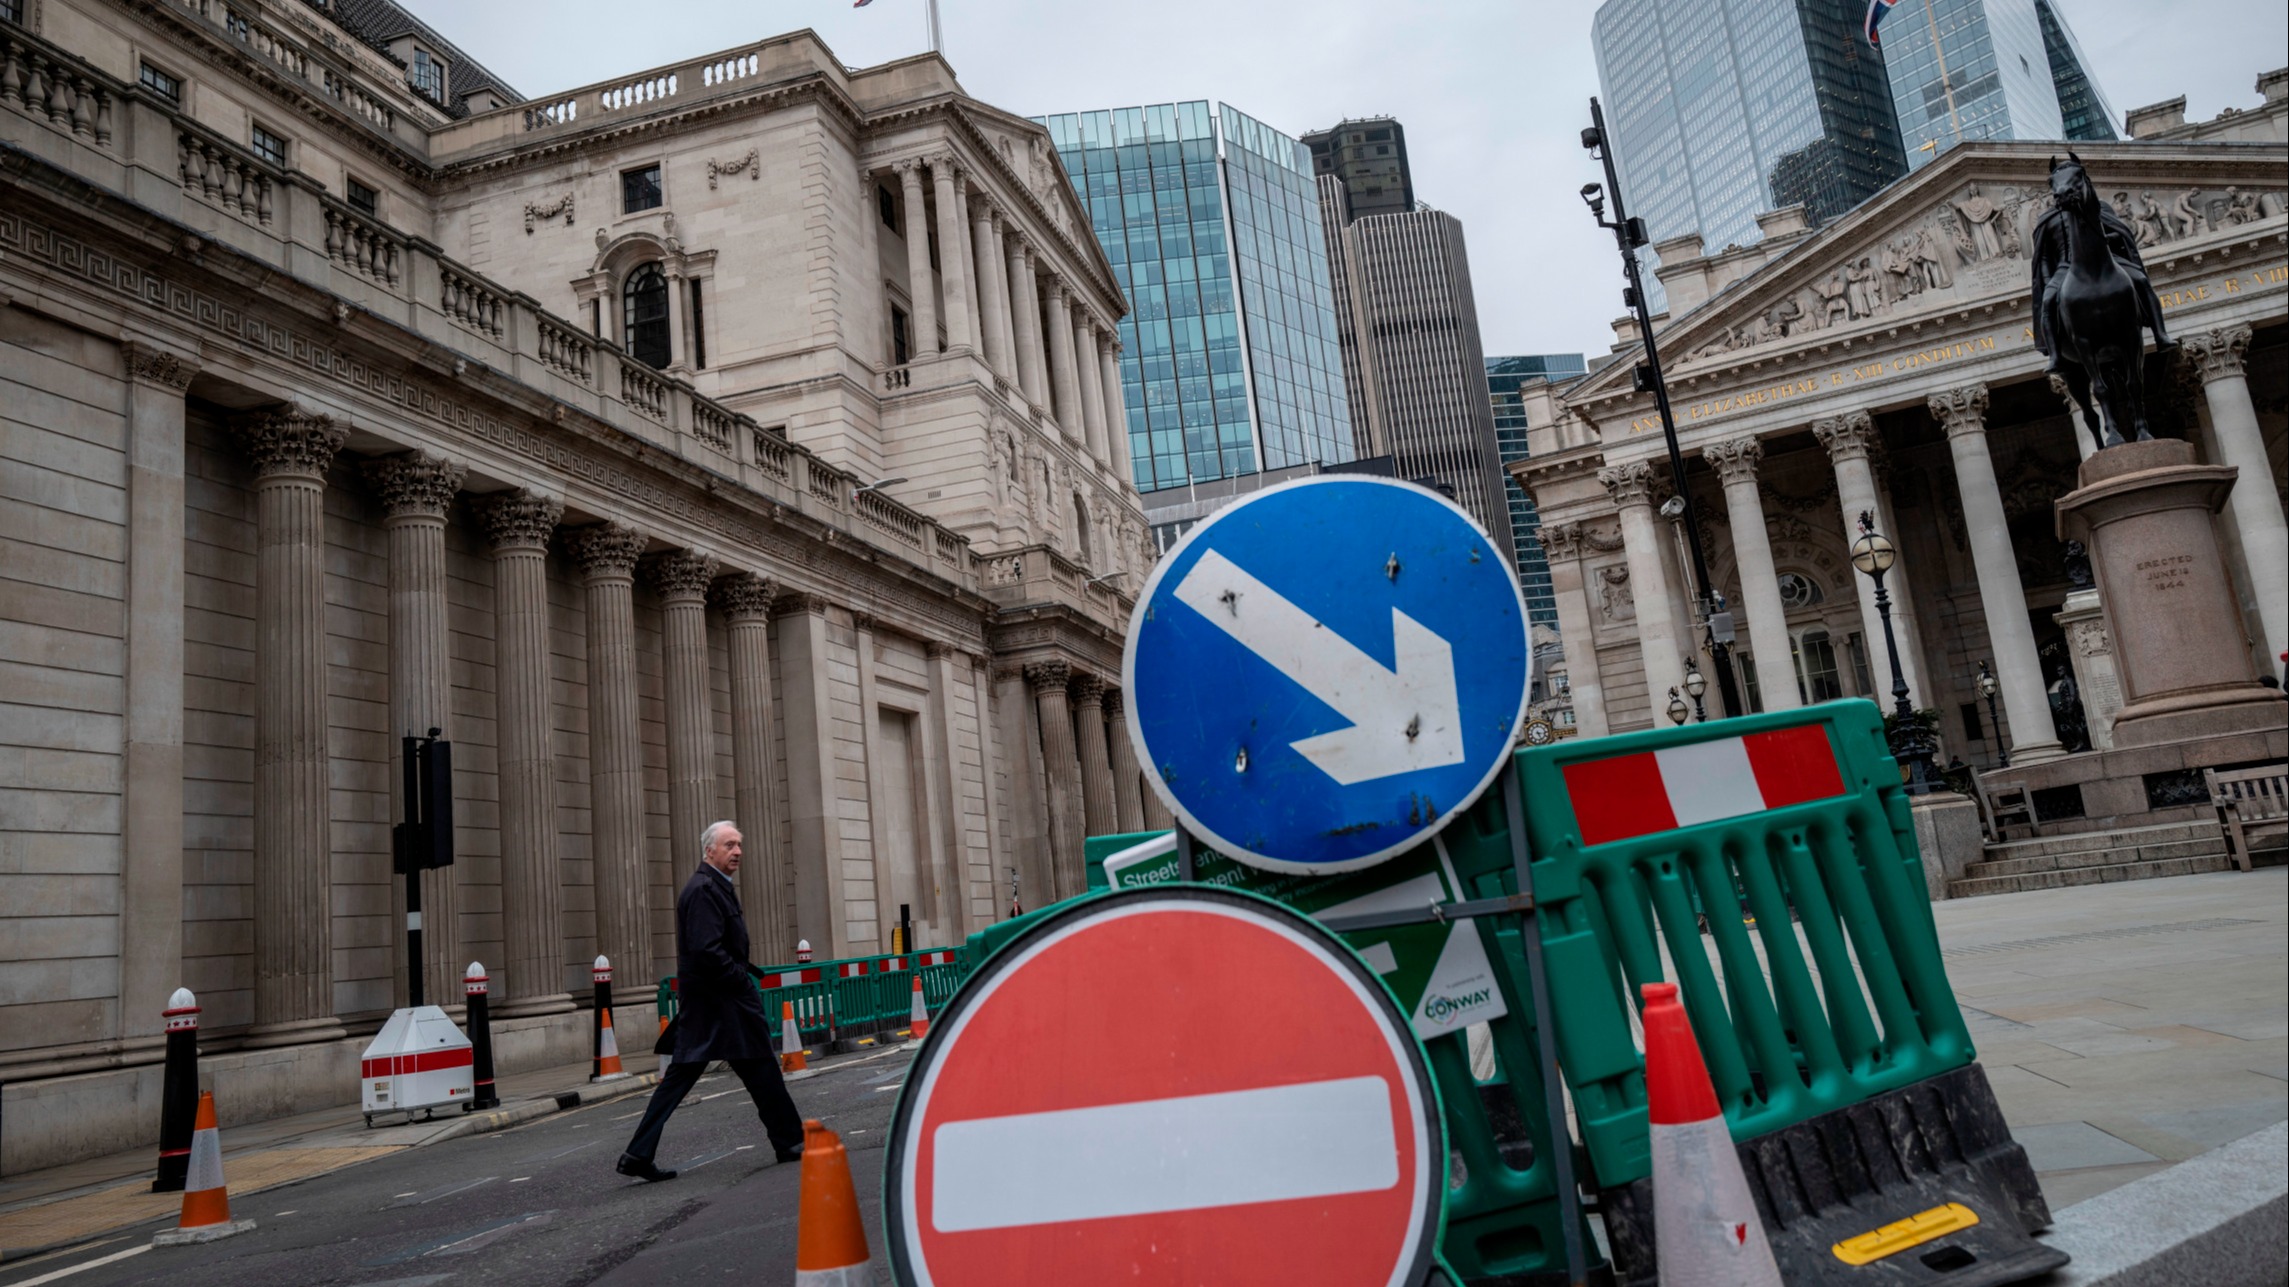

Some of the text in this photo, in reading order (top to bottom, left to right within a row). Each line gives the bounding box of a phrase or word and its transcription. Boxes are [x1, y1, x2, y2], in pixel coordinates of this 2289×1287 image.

[2225, 277, 2241, 294] R
[1691, 376, 1819, 420] ELIZABETHAE
[1831, 371, 1844, 387] R
[1853, 361, 1884, 382] XIII
[1894, 335, 1996, 371] CONDITVM
[2136, 555, 2193, 571] ERECTED
[2147, 569, 2177, 580] JUNE
[2155, 580, 2185, 591] 1844
[1425, 987, 1490, 1018] CONWAY
